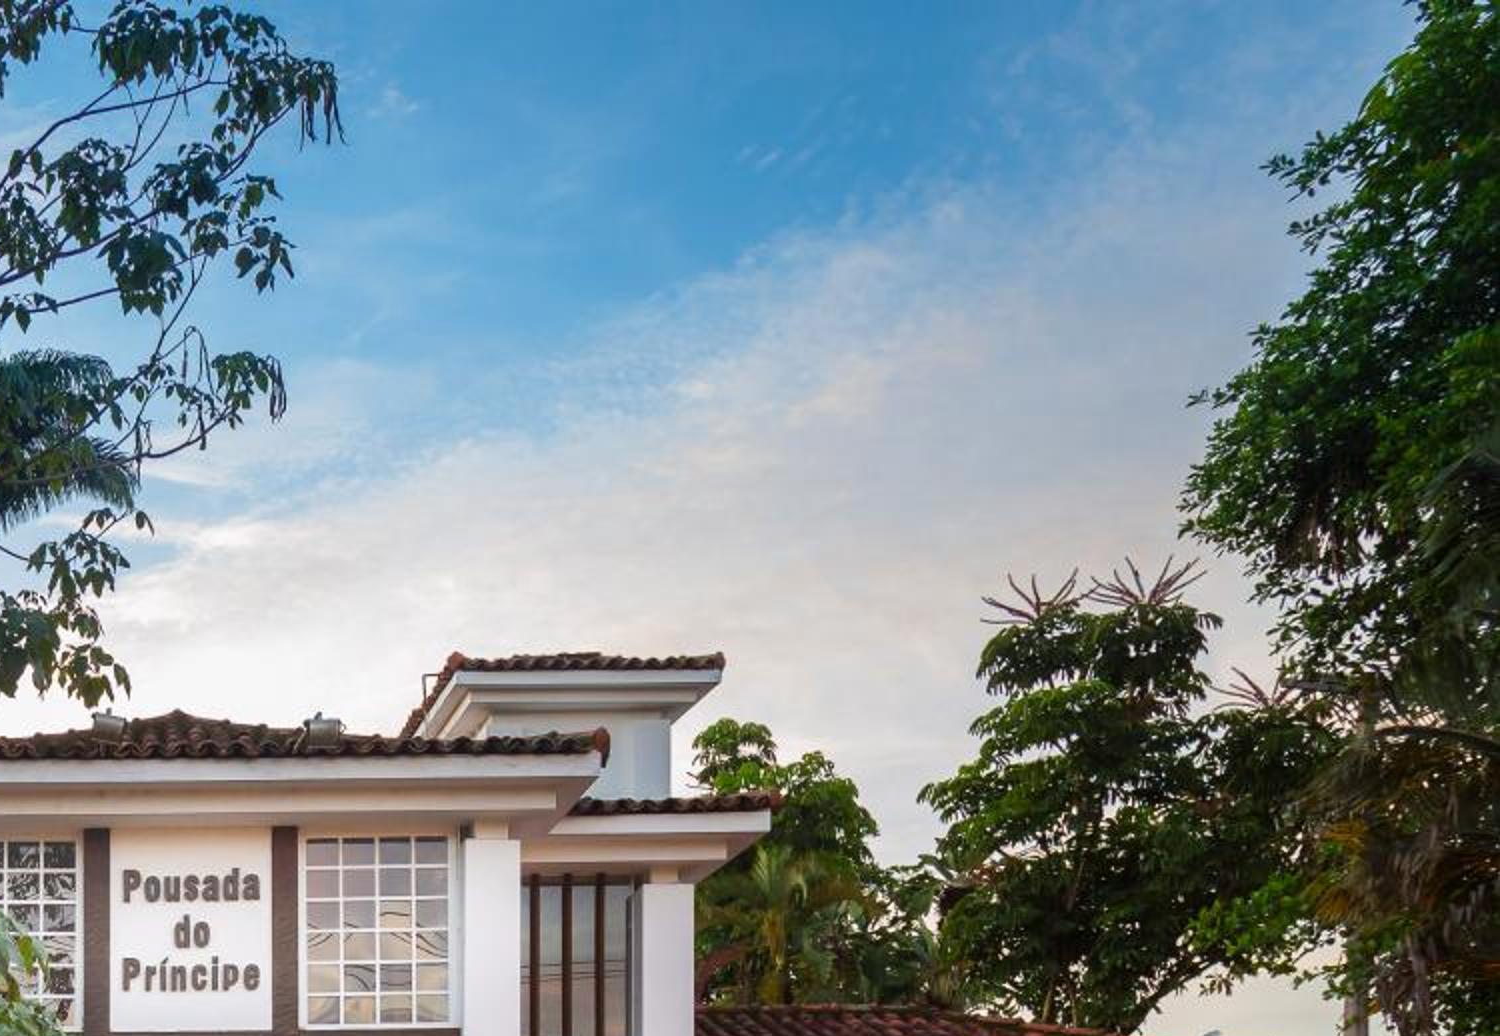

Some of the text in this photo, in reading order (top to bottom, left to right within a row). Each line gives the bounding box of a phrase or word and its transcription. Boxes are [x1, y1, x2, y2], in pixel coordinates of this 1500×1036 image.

[122, 868, 261, 903] Pousada
[173, 914, 211, 949] do
[122, 955, 261, 992] Príncipe
